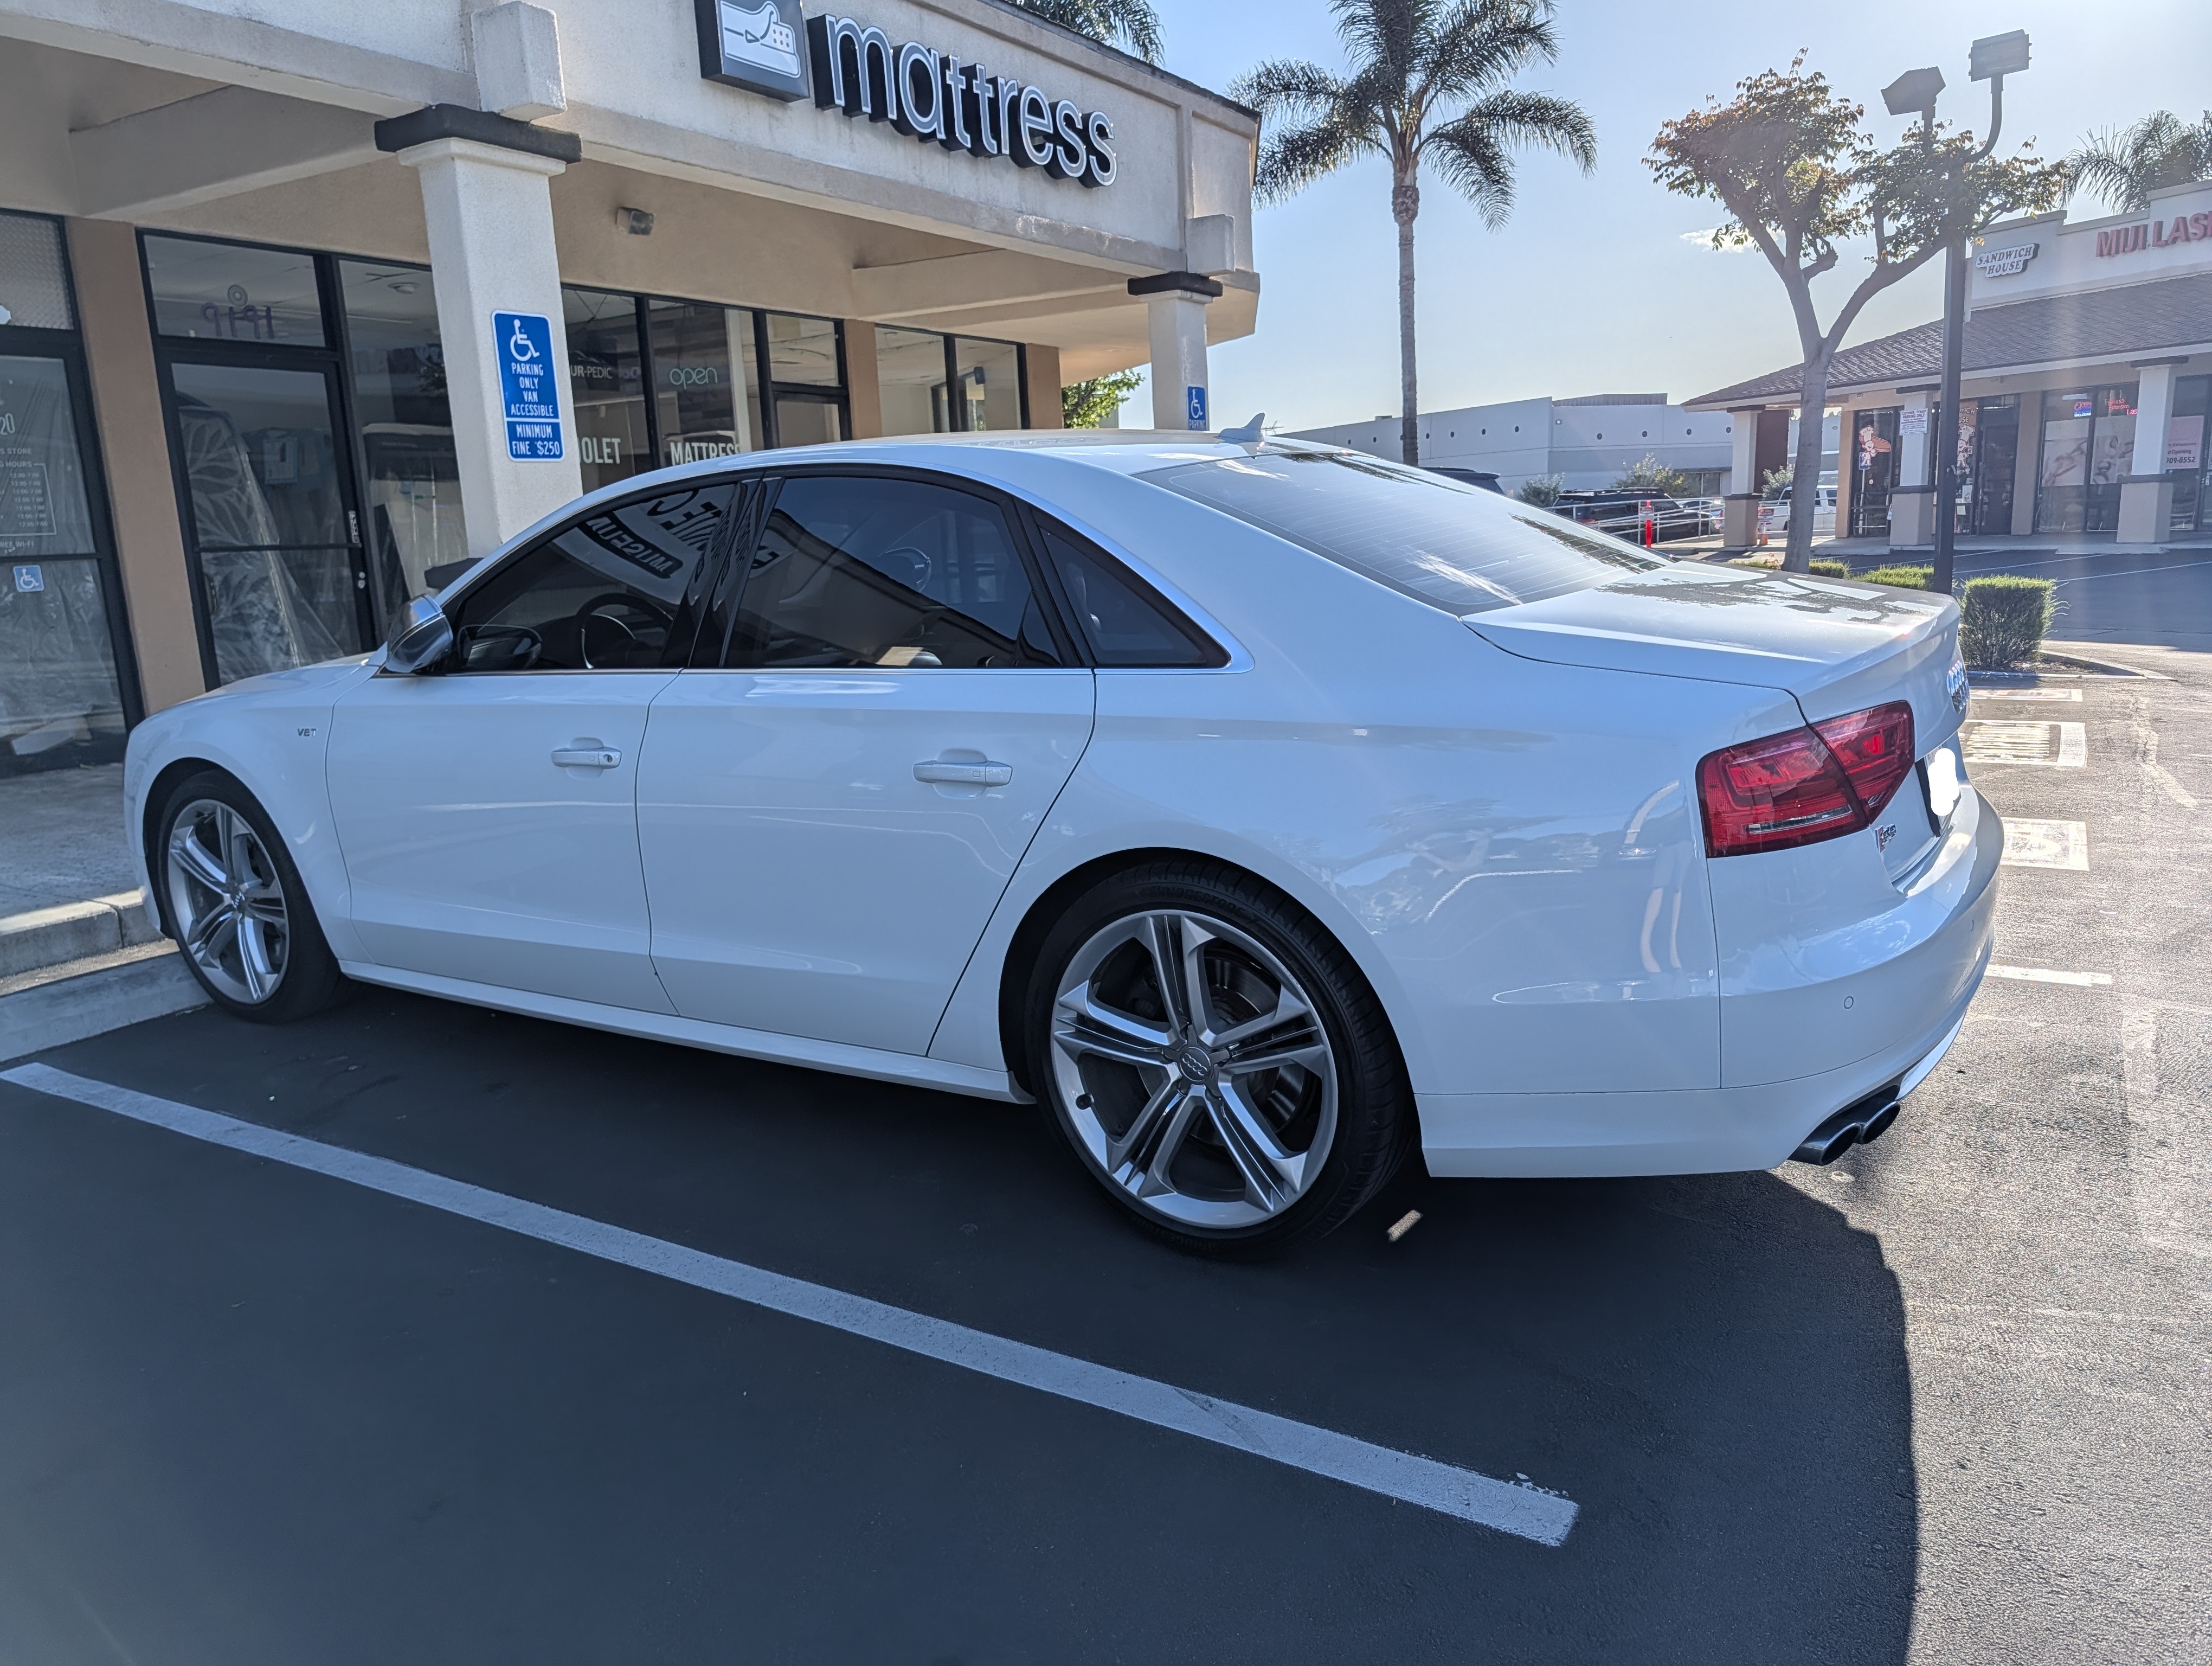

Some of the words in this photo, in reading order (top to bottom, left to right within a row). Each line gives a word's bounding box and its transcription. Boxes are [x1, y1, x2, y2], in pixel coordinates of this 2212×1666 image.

[807, 13, 1118, 188] mattress
[1977, 246, 2033, 266] SANDWICH
[1987, 260, 2022, 275] HOUSE
[511, 362, 544, 376] PARKING
[519, 376, 538, 389] ONLY
[670, 367, 718, 390] open
[523, 390, 538, 402] VAN
[511, 403, 554, 416] ACCESSIBLE
[516, 424, 552, 438] MINIMUM
[512, 440, 531, 455] FINE
[537, 440, 560, 456] $250
[578, 437, 621, 464] OLET
